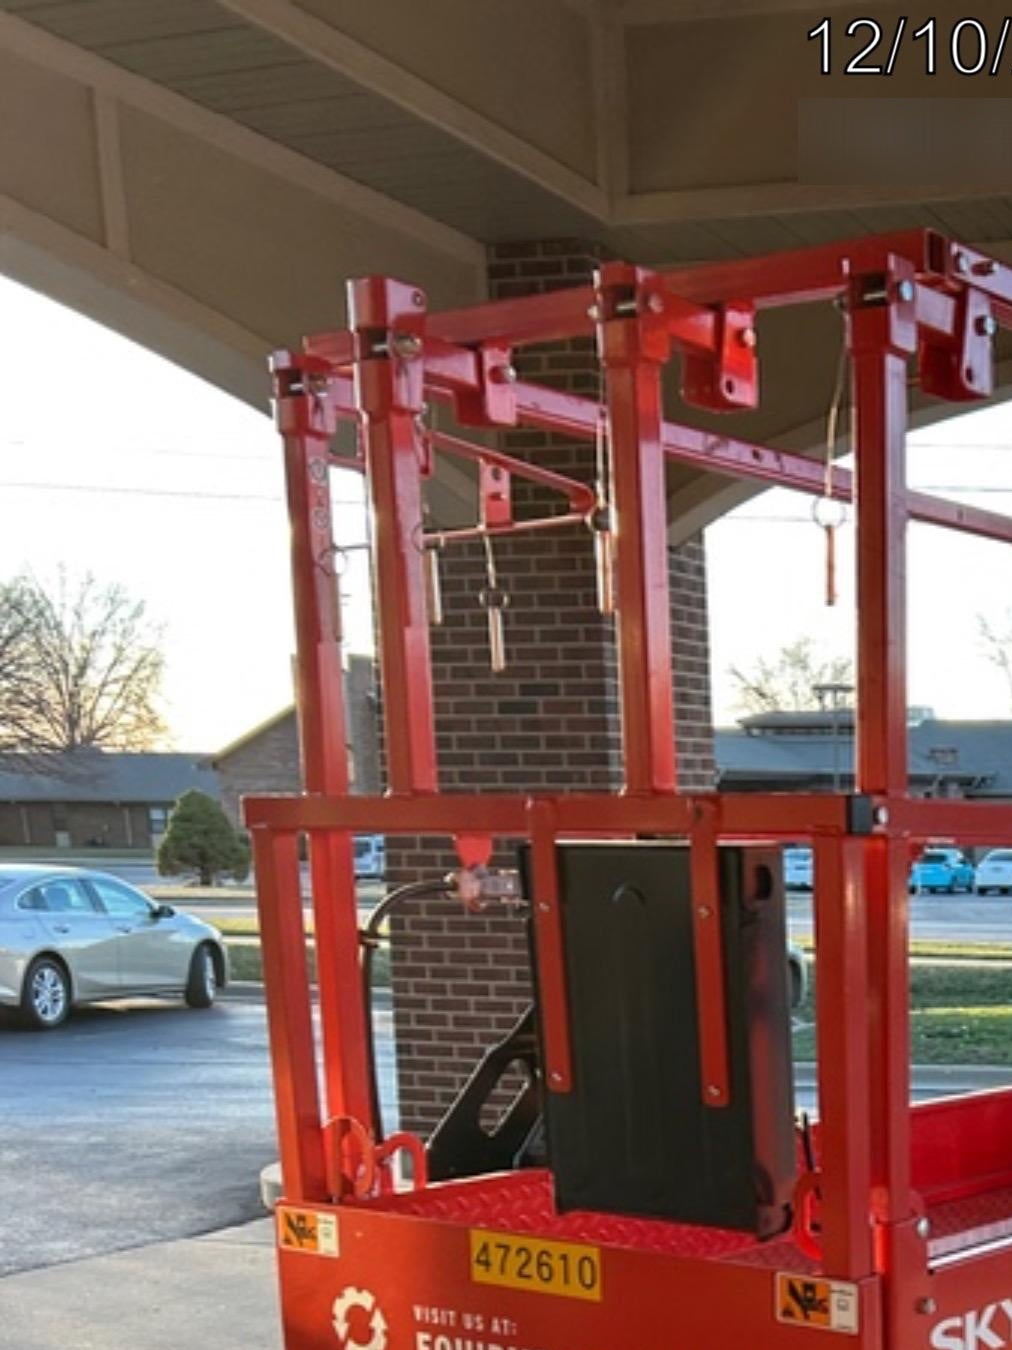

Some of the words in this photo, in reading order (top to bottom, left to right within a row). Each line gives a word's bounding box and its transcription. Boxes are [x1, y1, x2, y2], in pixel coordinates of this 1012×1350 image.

[475, 1241, 597, 1290] 472610
[413, 1304, 457, 1327] VISIT
[462, 1312, 484, 1333] US
[491, 1317, 518, 1336] AT:
